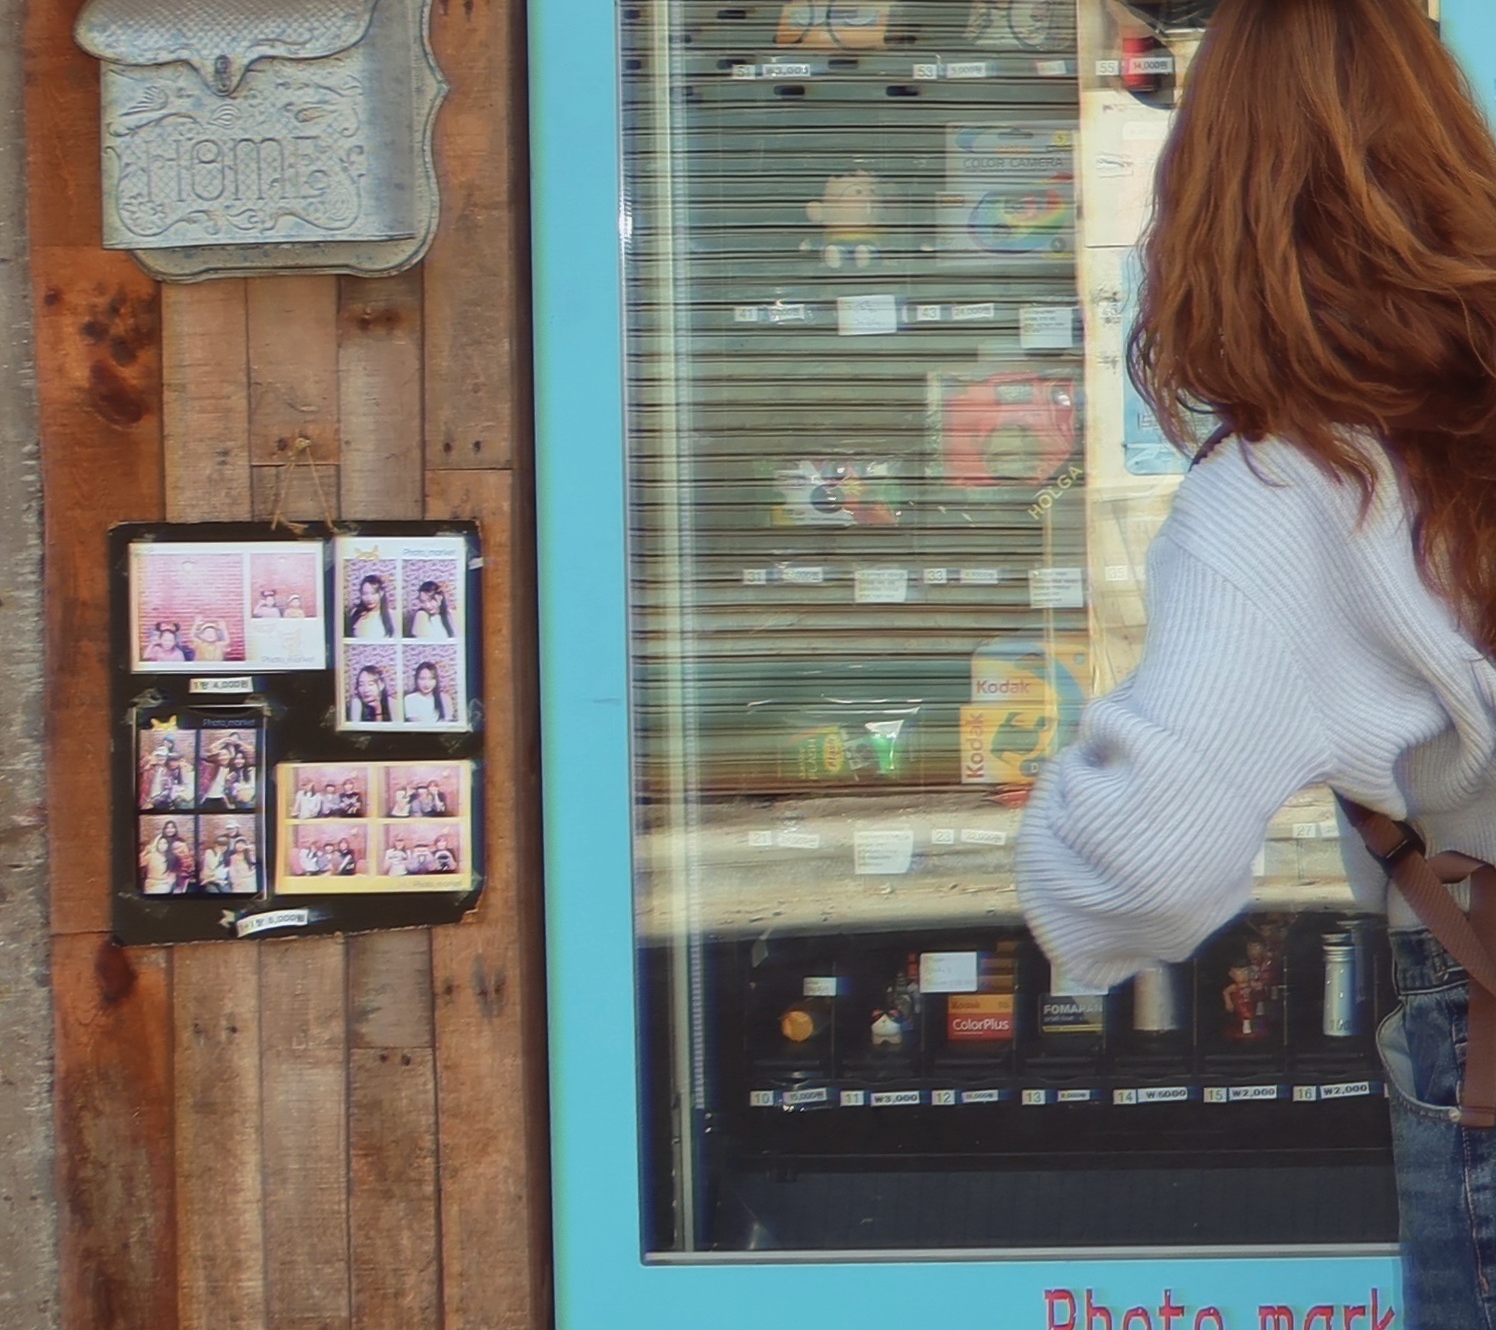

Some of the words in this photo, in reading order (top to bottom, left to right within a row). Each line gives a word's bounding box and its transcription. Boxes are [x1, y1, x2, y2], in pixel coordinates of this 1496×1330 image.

[917, 66, 933, 78] 53
[1100, 62, 1115, 74] 55
[963, 157, 1006, 169] COLOR
[1009, 156, 1064, 168] CAMERA
[140, 136, 330, 204] HOME
[1028, 465, 1084, 520] HOLGA
[928, 571, 943, 582] 33
[976, 679, 1031, 694] Kodak
[965, 713, 985, 779] Kodak
[1043, 1003, 1103, 1015] FOMAPAN
[952, 1017, 1010, 1032] ColorPlus
[755, 1093, 770, 1104] 10
[846, 1093, 860, 1104] 11
[937, 1092, 951, 1103] 12
[1026, 1092, 1041, 1103] 13
[1117, 1090, 1133, 1102] 14
[1209, 1089, 1223, 1100] 15
[1298, 1088, 1312, 1100] 16
